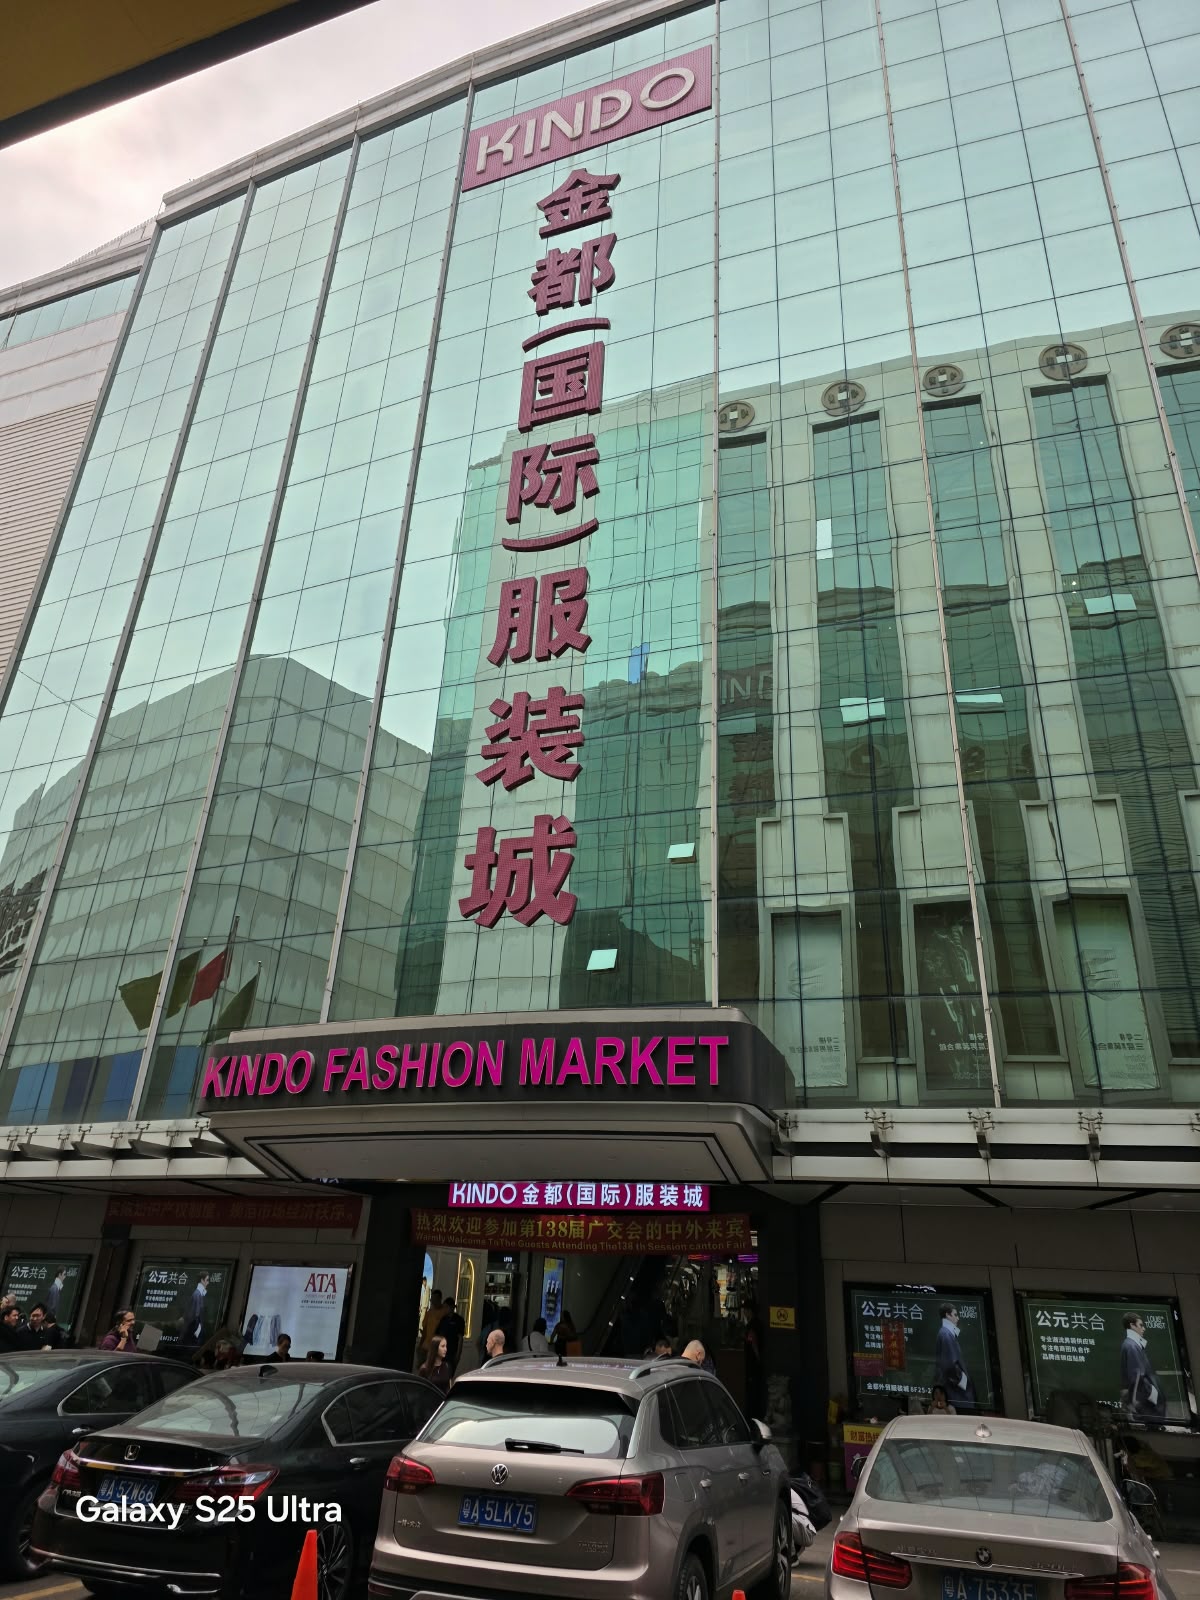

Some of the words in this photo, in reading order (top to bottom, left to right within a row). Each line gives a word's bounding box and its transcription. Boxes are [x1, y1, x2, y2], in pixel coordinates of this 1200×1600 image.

[476, 67, 696, 174] KINDO
[459, 168, 621, 929] 金都(国际)服装城
[202, 1051, 315, 1098] KINDO
[323, 1039, 505, 1092] FASHION
[518, 1035, 729, 1087] MARKET
[452, 1182, 517, 1205] KINDO
[416, 1213, 745, 1241] 热烈欢迎参加第138届广交会的中外来宾
[416, 1232, 446, 1244] Warmly
[448, 1235, 486, 1245] Welcome
[11, 1265, 48, 1279] 公元共合
[148, 1270, 188, 1285] 公元共合
[303, 1273, 337, 1293] ATA
[861, 1301, 924, 1321] 公元共合
[1036, 1310, 1105, 1332] 公元共合
